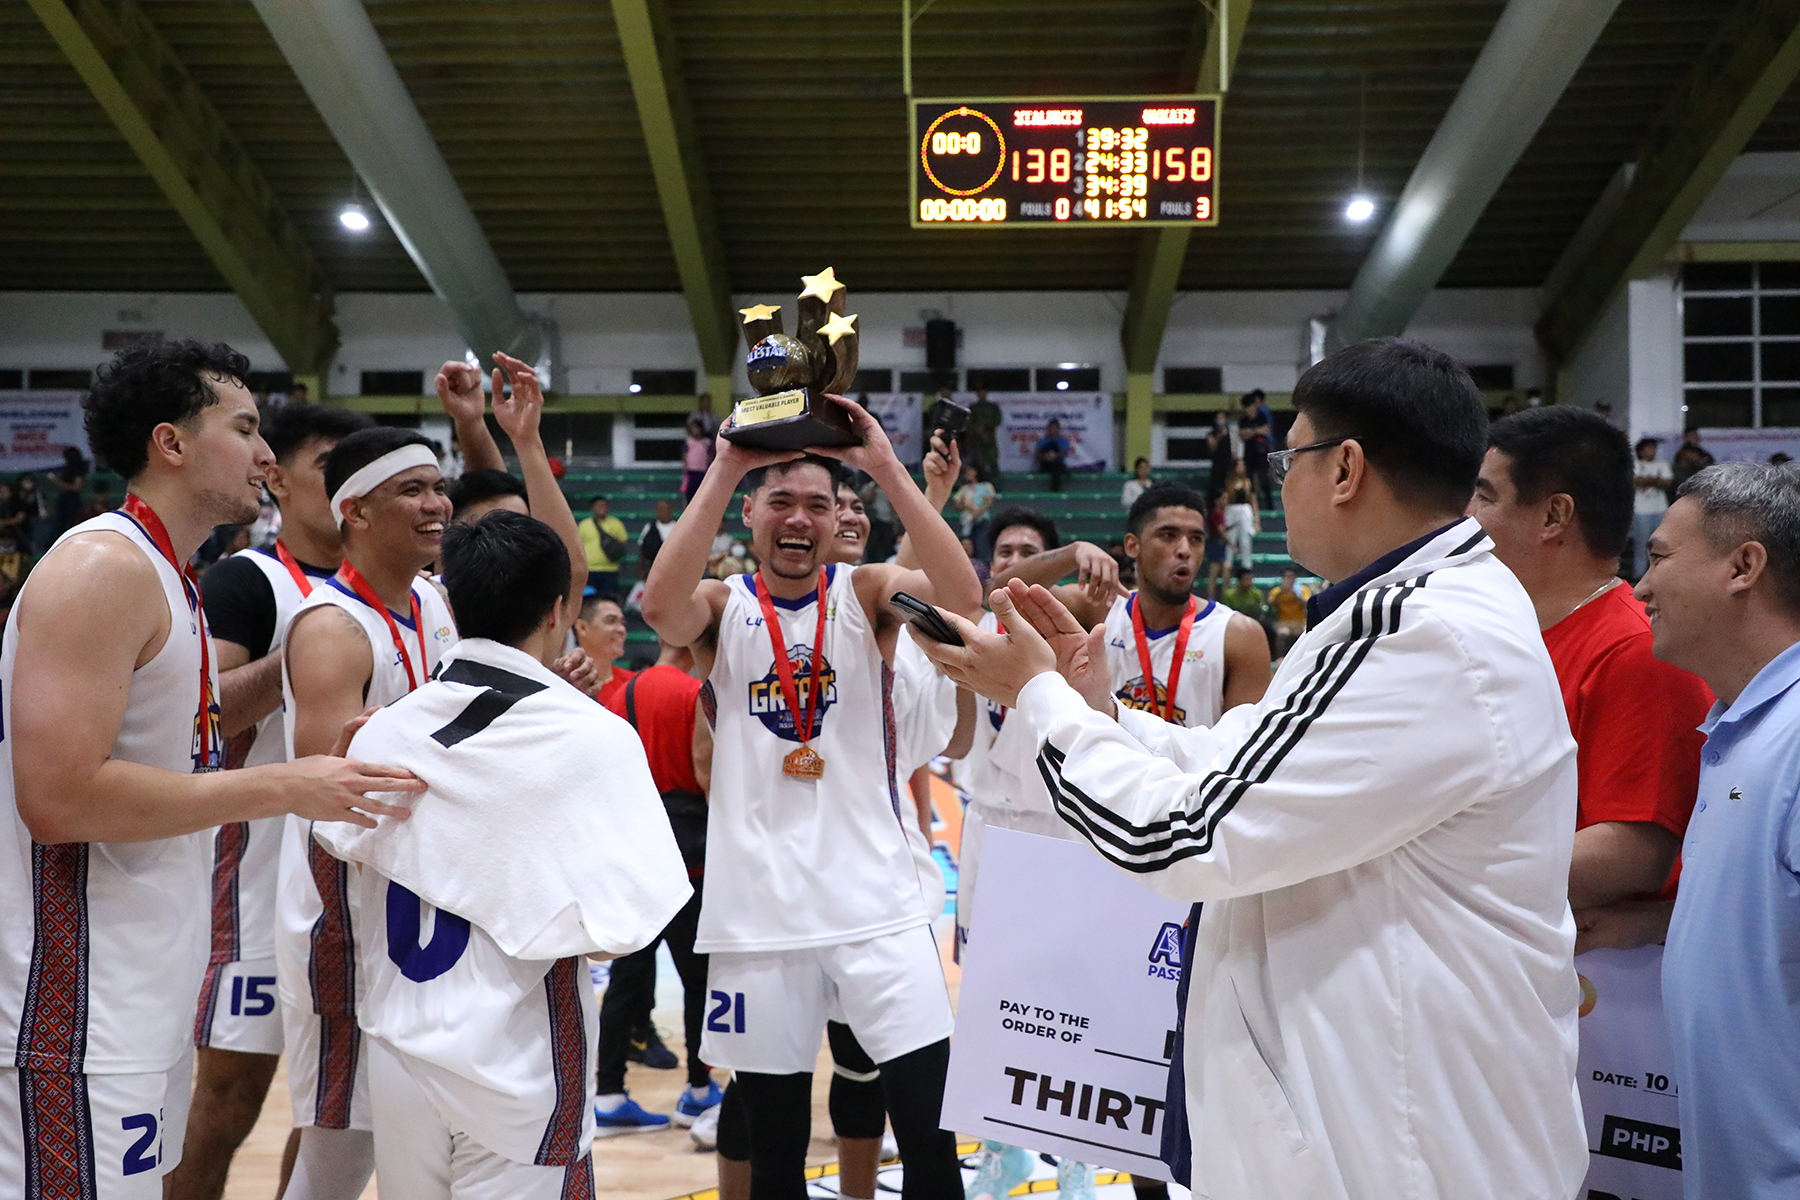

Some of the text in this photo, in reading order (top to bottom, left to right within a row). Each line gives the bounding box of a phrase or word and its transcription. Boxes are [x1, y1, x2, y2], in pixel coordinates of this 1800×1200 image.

[1075, 127, 1149, 150] 1 39:32
[1011, 148, 1071, 183] 138
[1074, 150, 1148, 174] 2 24:33
[1152, 147, 1212, 182] 158
[1074, 174, 1148, 197] 3 34:39
[920, 198, 1007, 222] 00:00:00
[1020, 197, 1071, 221] FOULS 0
[1073, 198, 1148, 219] 4 41:54
[1160, 196, 1211, 219] FOULS 3
[756, 400, 780, 411] VALUABLE
[781, 397, 799, 406] PLAYER
[230, 976, 276, 1016] 15
[707, 989, 746, 1034] 21
[1000, 1000, 1090, 1029] PAY TO THE
[1002, 1018, 1083, 1044] ORDER OF
[1592, 1070, 1638, 1089] DATE:
[1645, 1072, 1669, 1092] 10
[1612, 1127, 1670, 1154] PHP
